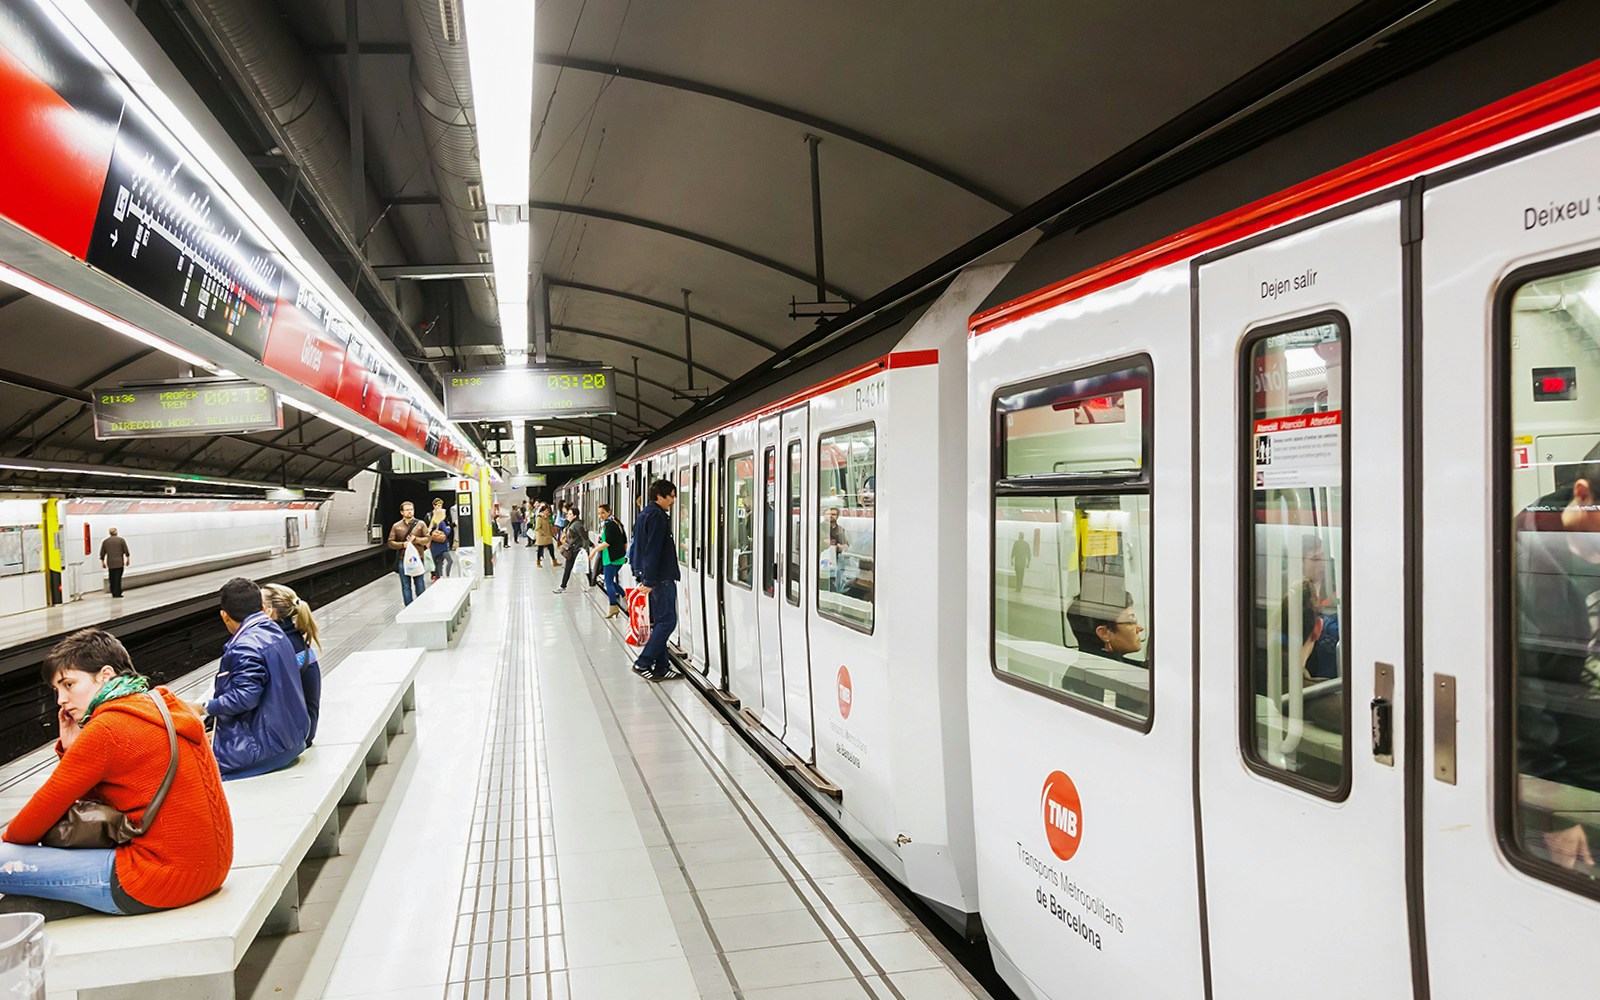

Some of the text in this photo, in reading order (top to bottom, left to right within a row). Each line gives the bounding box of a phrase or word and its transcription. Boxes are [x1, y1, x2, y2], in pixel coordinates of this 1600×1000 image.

[1524, 198, 1590, 230] Deixeu
[1261, 268, 1318, 300] Dejen salir
[452, 378, 482, 387] 21:36
[548, 374, 606, 389] 03:20
[102, 394, 136, 405] 21:36
[1048, 798, 1078, 838] TMB
[1016, 841, 1125, 934] Transports Metropolitans
[1035, 885, 1103, 951] de Barcelona
